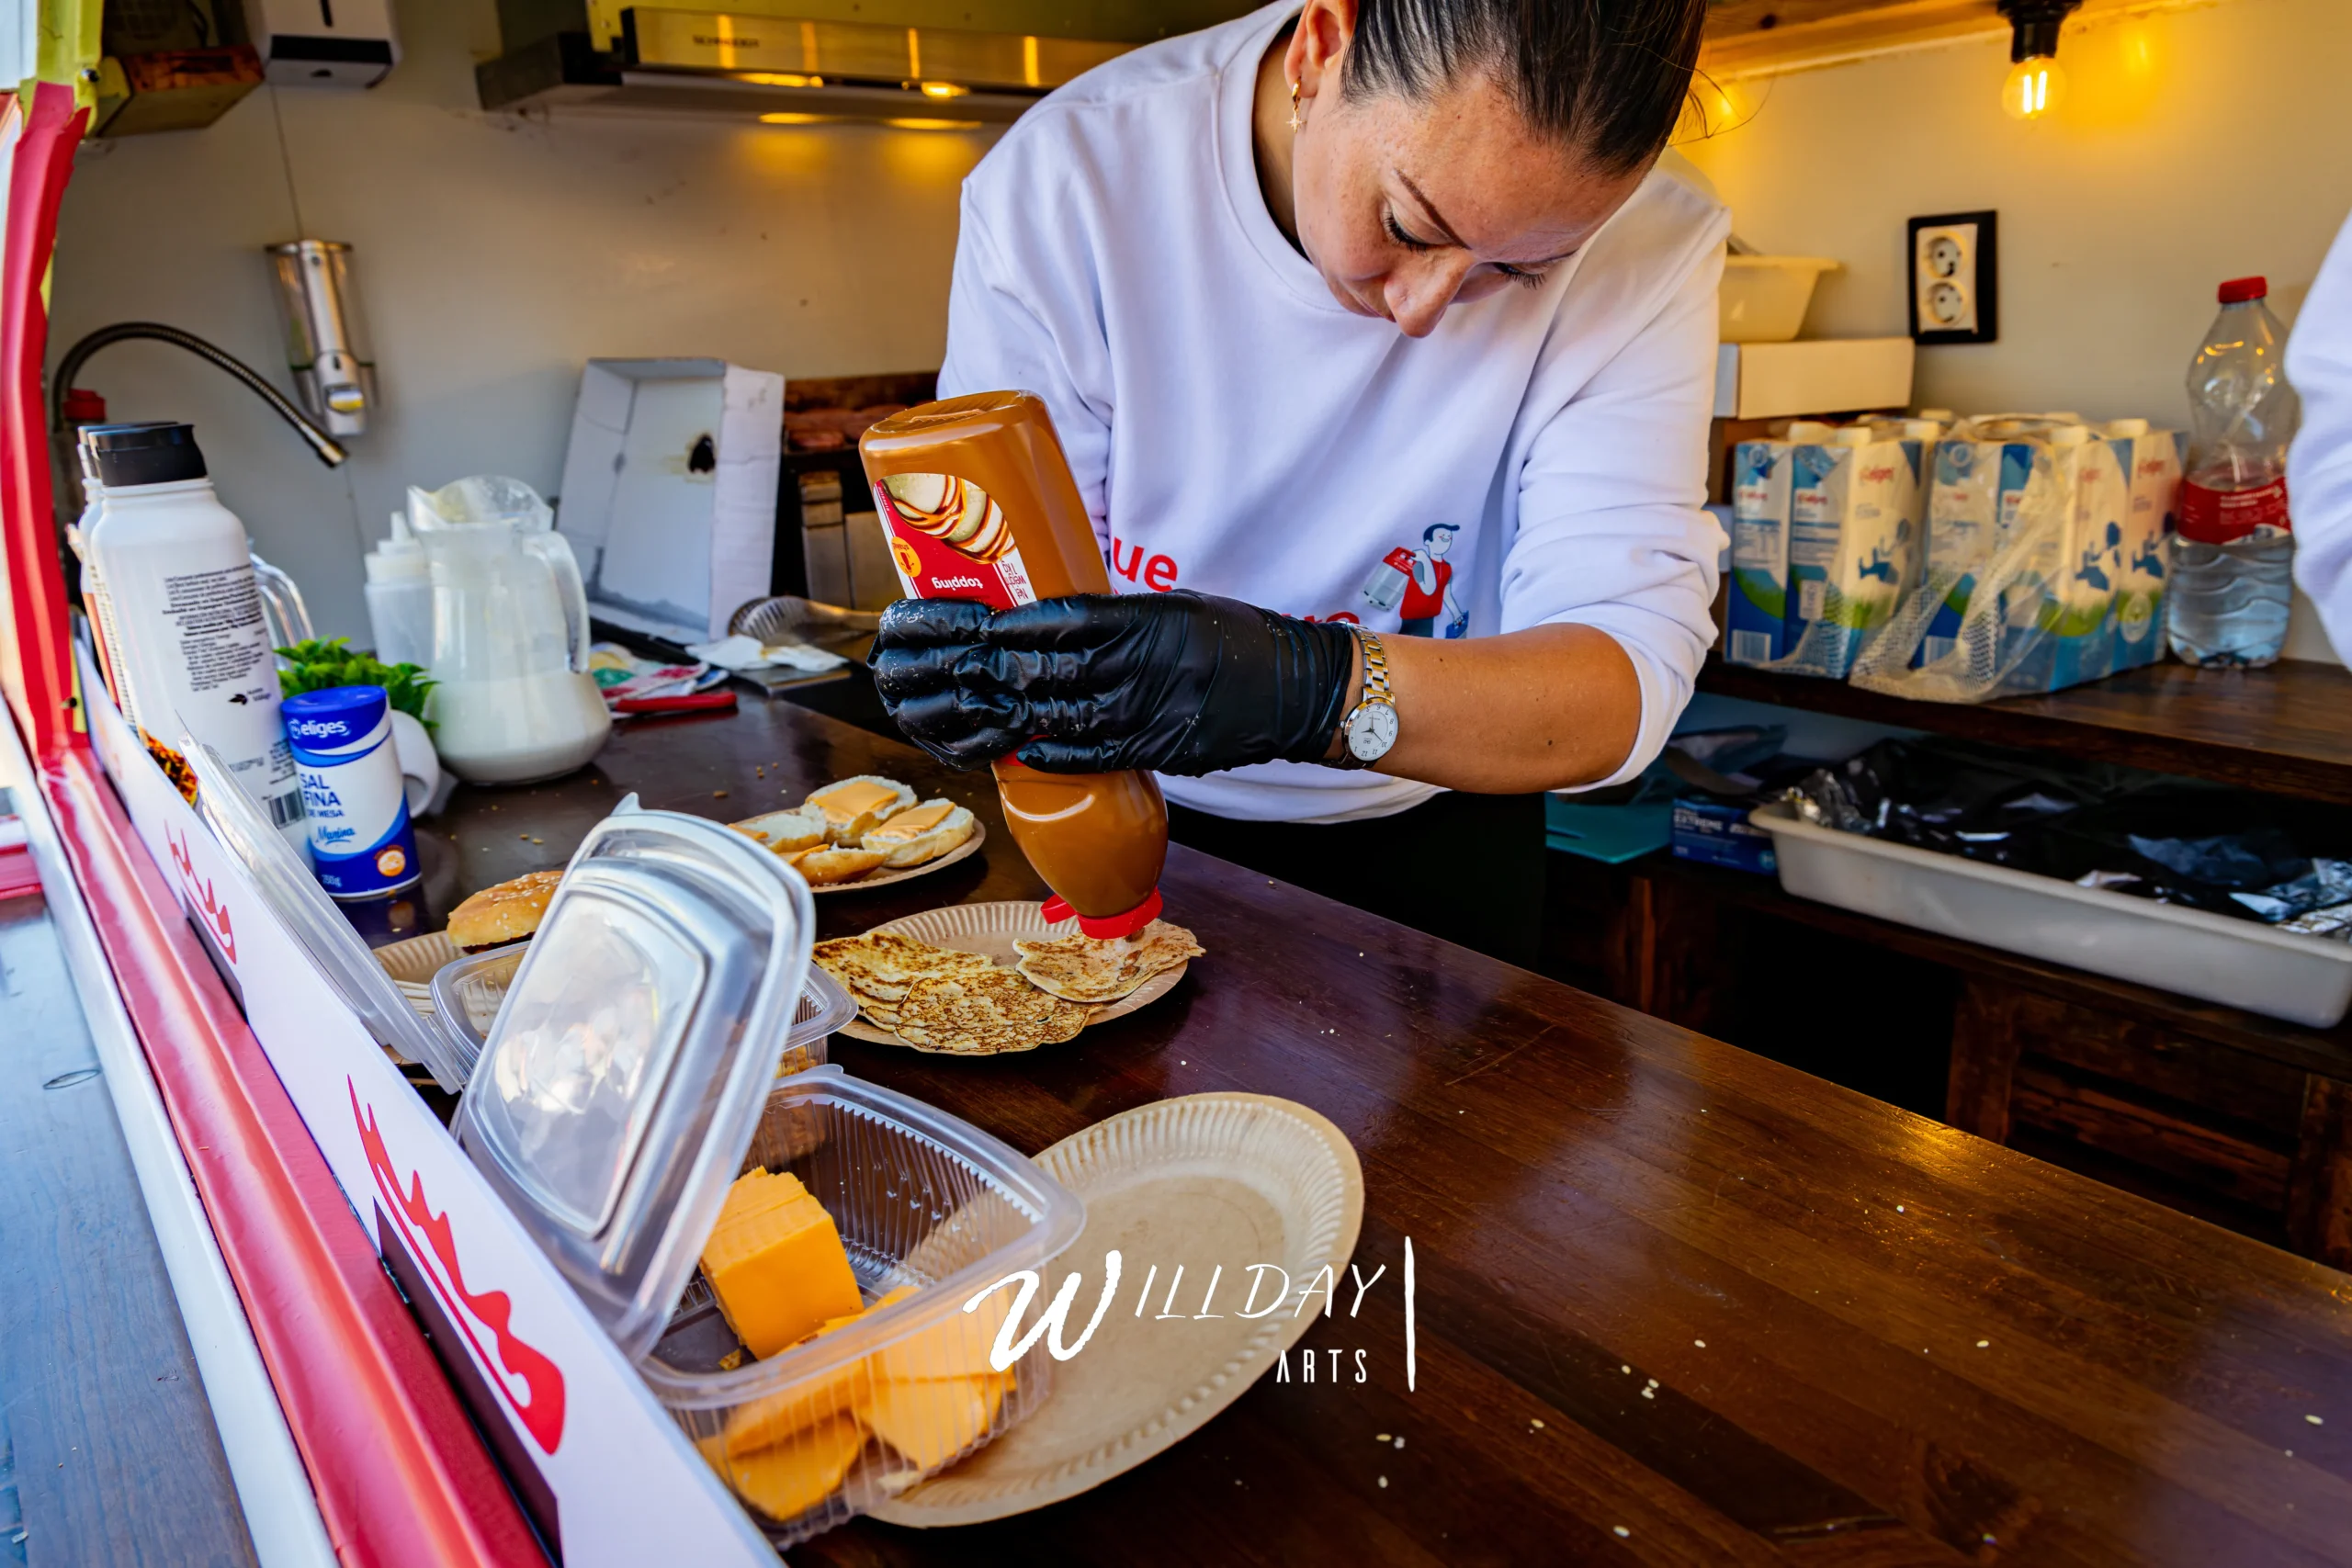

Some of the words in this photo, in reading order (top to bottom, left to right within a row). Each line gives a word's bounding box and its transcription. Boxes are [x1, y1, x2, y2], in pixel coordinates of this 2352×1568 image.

[931, 575, 983, 591] topping
[1015, 588, 1029, 600] Net
[300, 773, 330, 790] SAL
[304, 791, 342, 807] FINA
[318, 809, 345, 818] MESA
